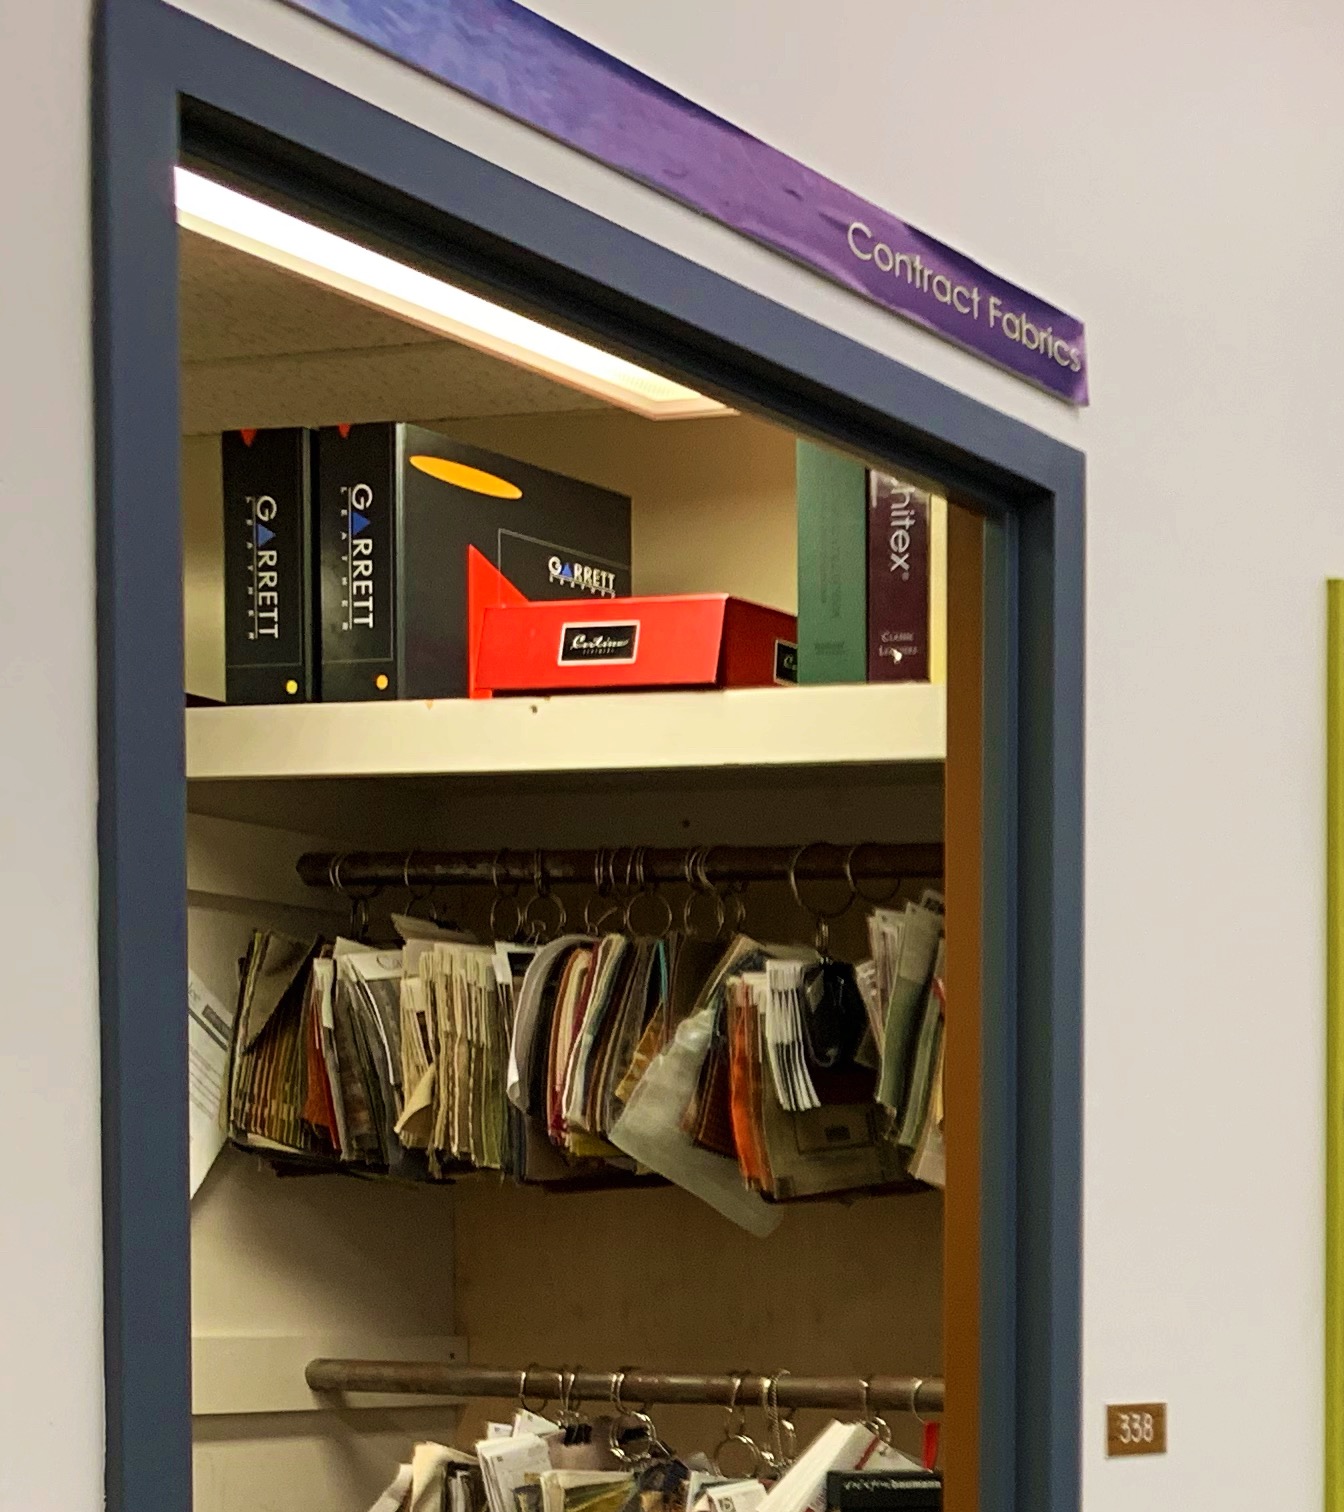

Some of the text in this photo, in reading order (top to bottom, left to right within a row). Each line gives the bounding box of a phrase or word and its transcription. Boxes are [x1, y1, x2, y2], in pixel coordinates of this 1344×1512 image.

[847, 221, 1082, 373] Contract Fabrics
[1118, 1412, 1154, 1444] 338
